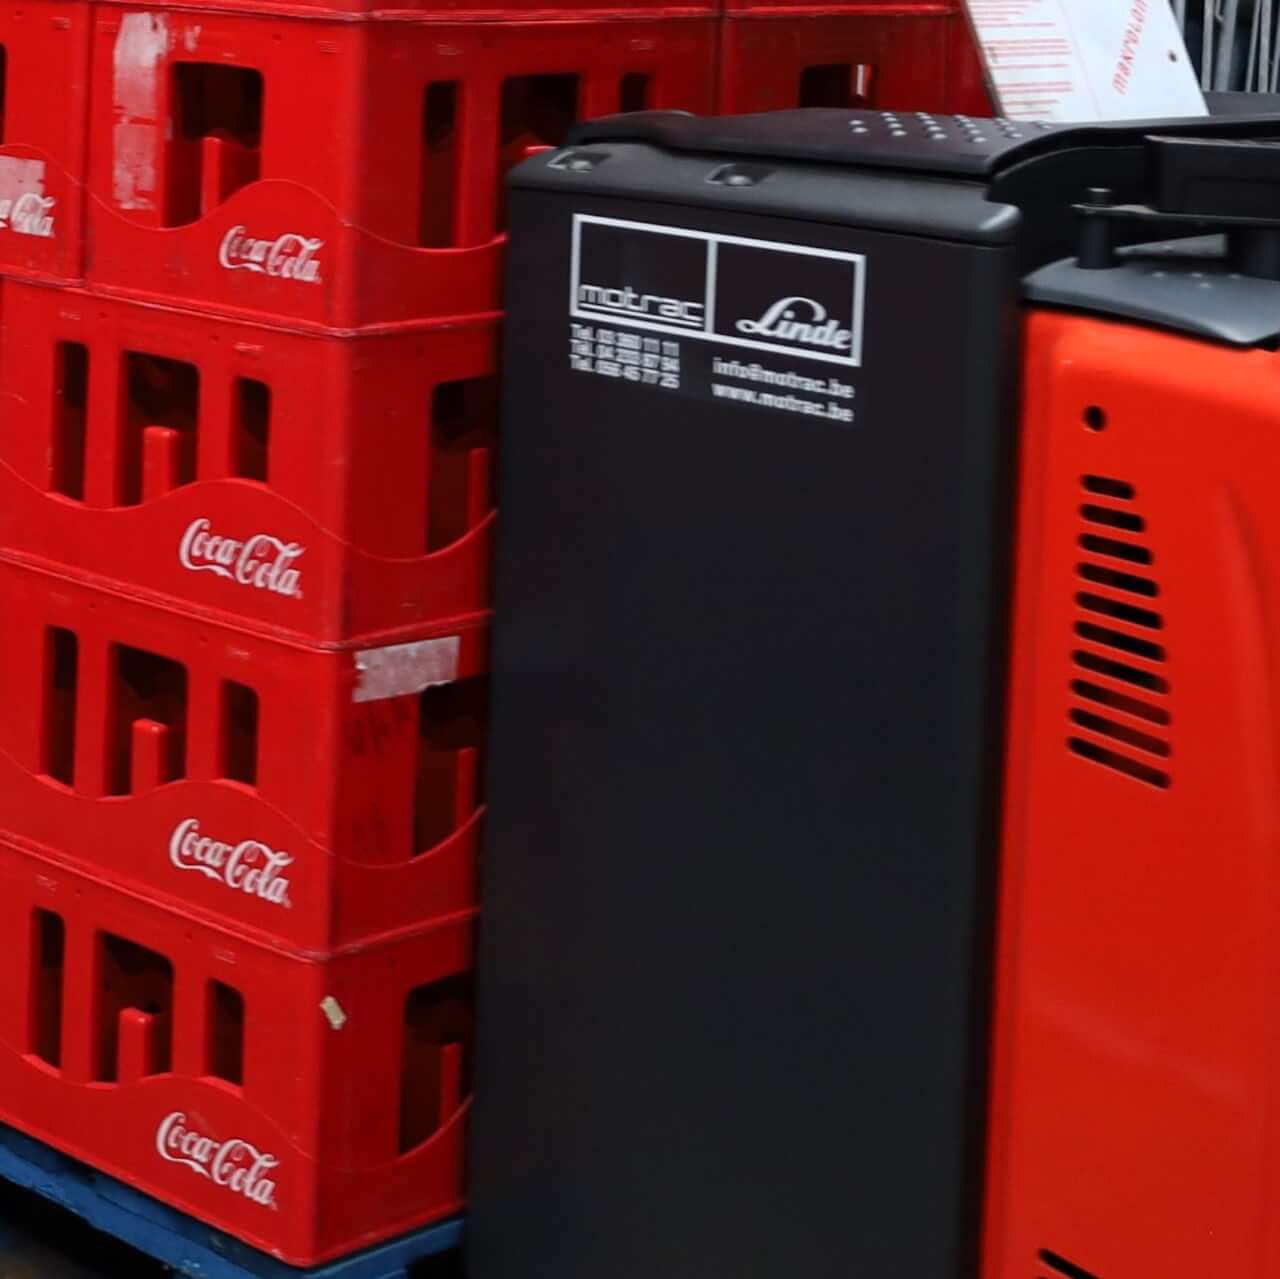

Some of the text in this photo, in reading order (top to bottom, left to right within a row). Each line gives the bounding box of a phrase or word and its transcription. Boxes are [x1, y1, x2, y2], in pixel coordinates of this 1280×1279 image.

[219, 225, 323, 282] Coca-Cola
[579, 283, 705, 322] motrac
[735, 296, 852, 350] Linde
[179, 518, 304, 598] Coca-Cola
[169, 818, 293, 907] Coca-Cola
[156, 1111, 279, 1208] Coca-Cola
